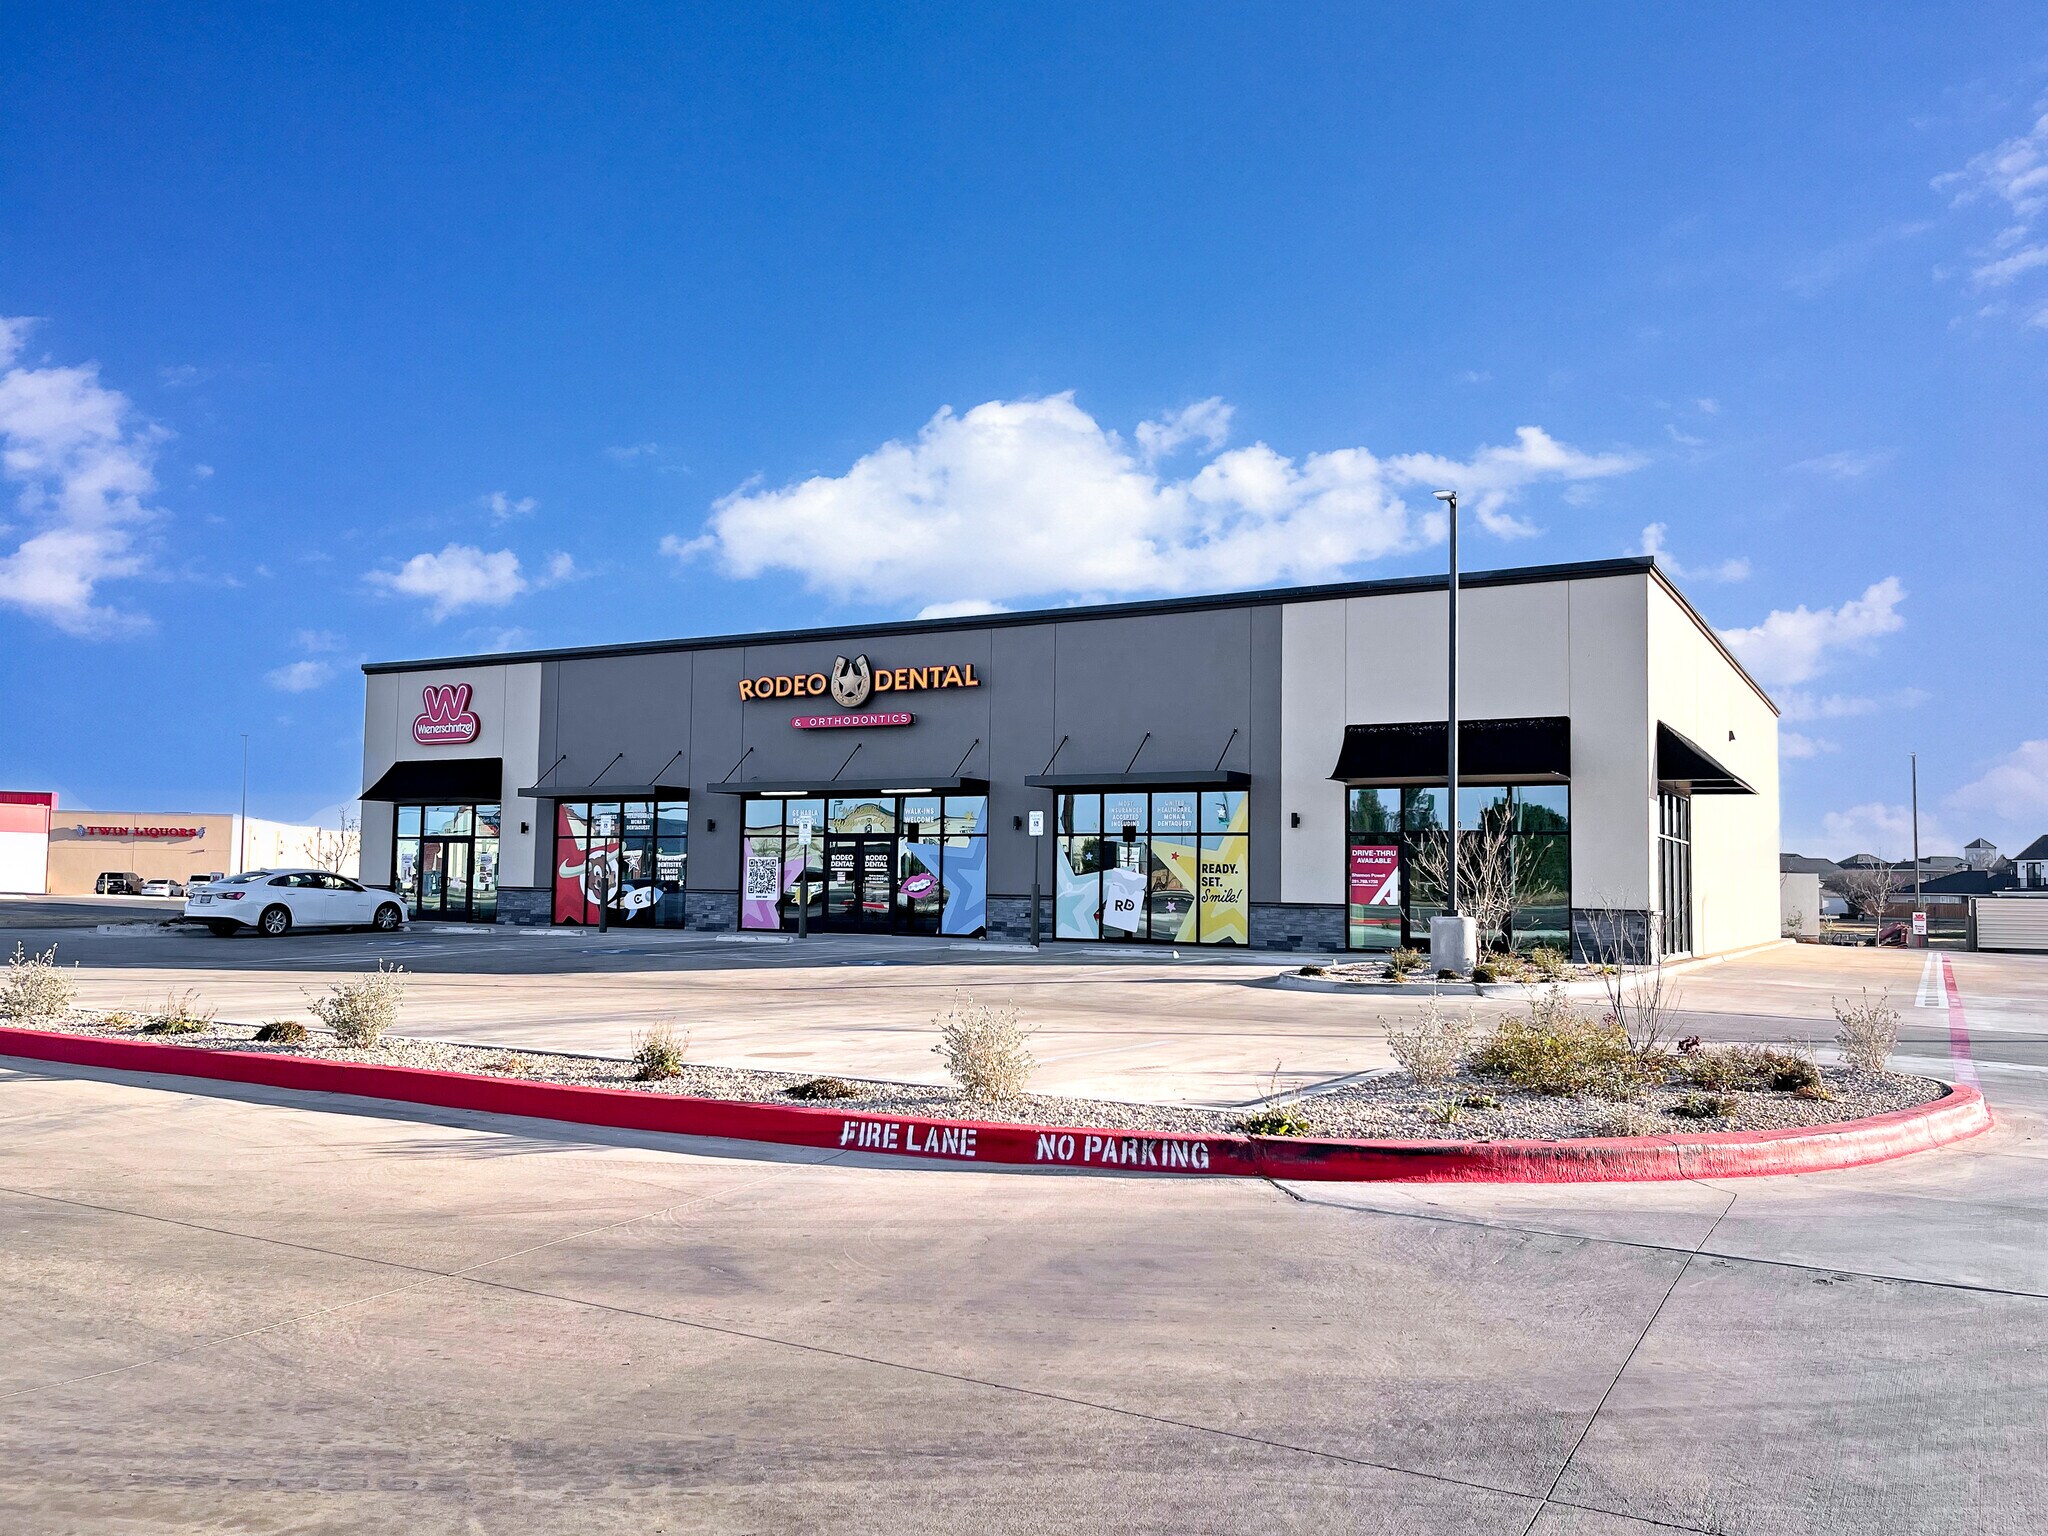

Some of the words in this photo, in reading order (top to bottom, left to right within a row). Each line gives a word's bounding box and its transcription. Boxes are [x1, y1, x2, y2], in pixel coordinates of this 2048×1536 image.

[738, 673, 827, 701] RODEO
[874, 664, 979, 692] DENTAL
[794, 719, 802, 727] &
[809, 714, 908, 726] ORTHODONTICS
[418, 722, 473, 735] Wienerschnitzel
[905, 807, 935, 815] WALK-INS
[87, 826, 129, 836] TWIN
[134, 827, 197, 838] LIQUORS
[1202, 863, 1239, 875] READY.
[1201, 876, 1223, 887] SET.
[1201, 888, 1243, 904] Smile!
[1114, 898, 1135, 912] RD
[839, 1121, 900, 1149] FIRE
[906, 1126, 977, 1157] LANE
[1036, 1133, 1076, 1161] NO
[1083, 1136, 1210, 1170] PARKING
